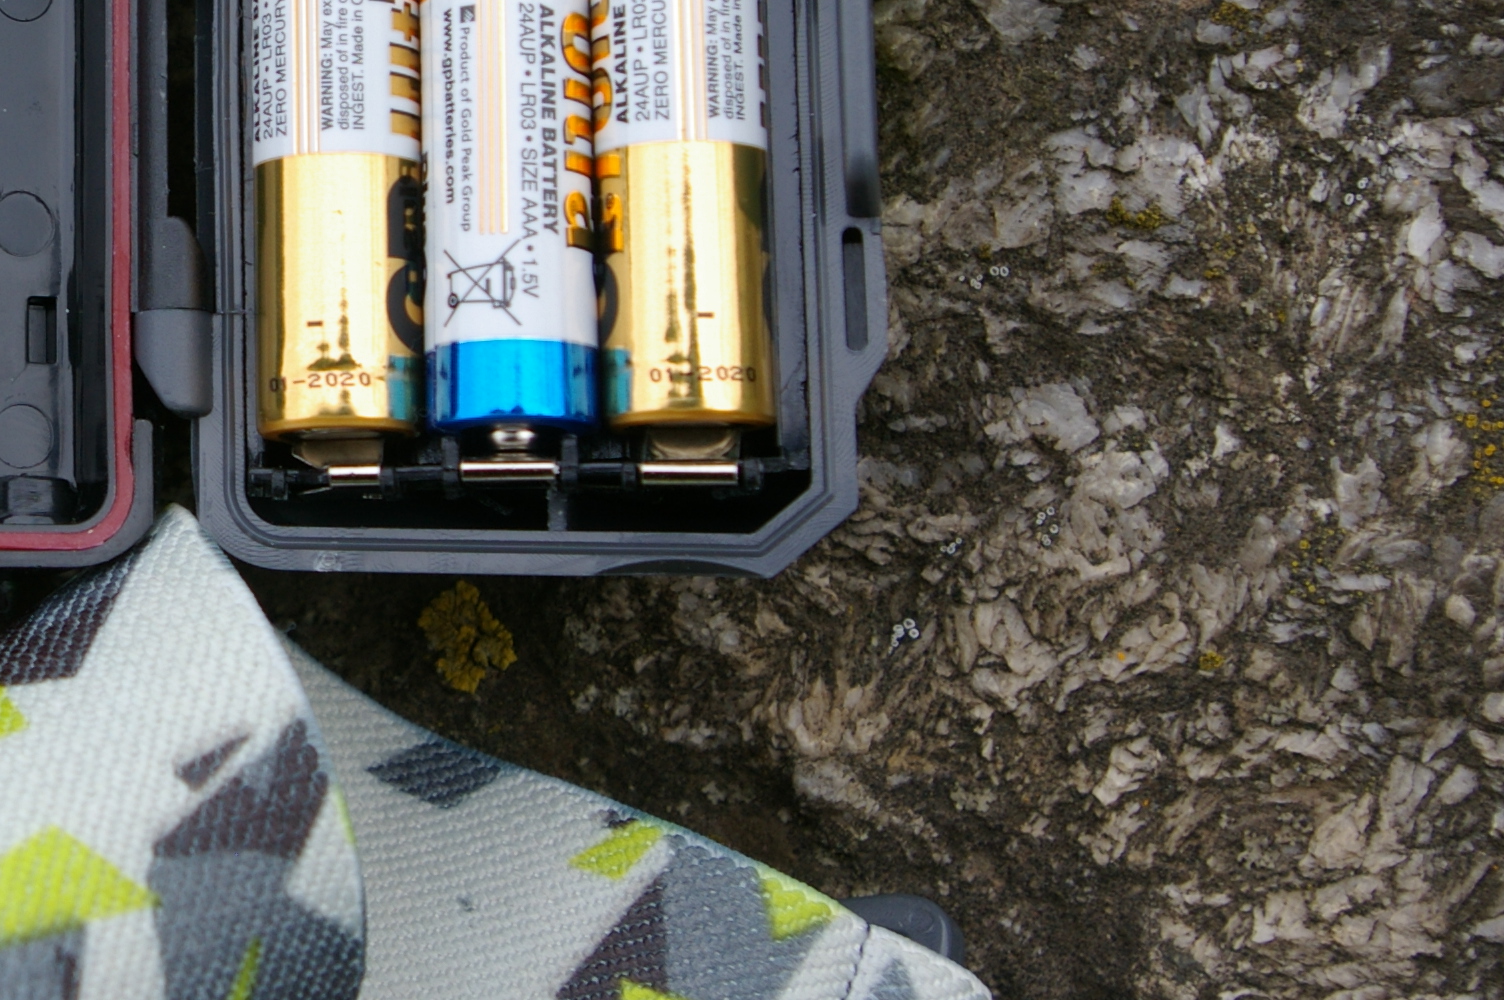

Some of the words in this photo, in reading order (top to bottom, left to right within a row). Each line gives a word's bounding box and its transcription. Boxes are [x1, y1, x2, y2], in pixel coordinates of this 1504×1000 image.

[261, 12, 273, 61] LR03
[320, 21, 337, 49] May
[335, 7, 348, 29] fire
[350, 9, 363, 22] in
[518, 2, 537, 65] 24AUP
[705, 7, 721, 35] May
[720, 22, 731, 34] in
[732, 14, 744, 54] Made
[336, 34, 348, 46] in
[336, 49, 348, 62] of
[351, 25, 364, 65] Made
[459, 27, 471, 84] Product
[539, 3, 557, 121] ALKALINE
[612, 4, 629, 124] ALKALINE
[720, 37, 732, 50] of
[321, 52, 334, 131] WARNING:
[336, 66, 354, 130] disposed
[352, 70, 365, 130] INGEST.
[460, 88, 472, 102] of
[633, 58, 650, 121] 24AUP
[653, 70, 670, 120] ZERO
[706, 39, 721, 119] WARNING:
[721, 54, 736, 120] disposed
[733, 59, 746, 121] INGEST.
[262, 78, 274, 140] 24AUP
[275, 88, 287, 137] ZERO
[441, 8, 456, 204] www.gpbatteries.com
[460, 108, 472, 143] Gold
[519, 82, 537, 130] LR03
[461, 147, 473, 182] Peak
[520, 147, 538, 192] SIZE
[541, 127, 559, 235] BATTERY
[460, 185, 473, 232] Group
[521, 197, 539, 239] AAA
[522, 258, 540, 299] 1.5V
